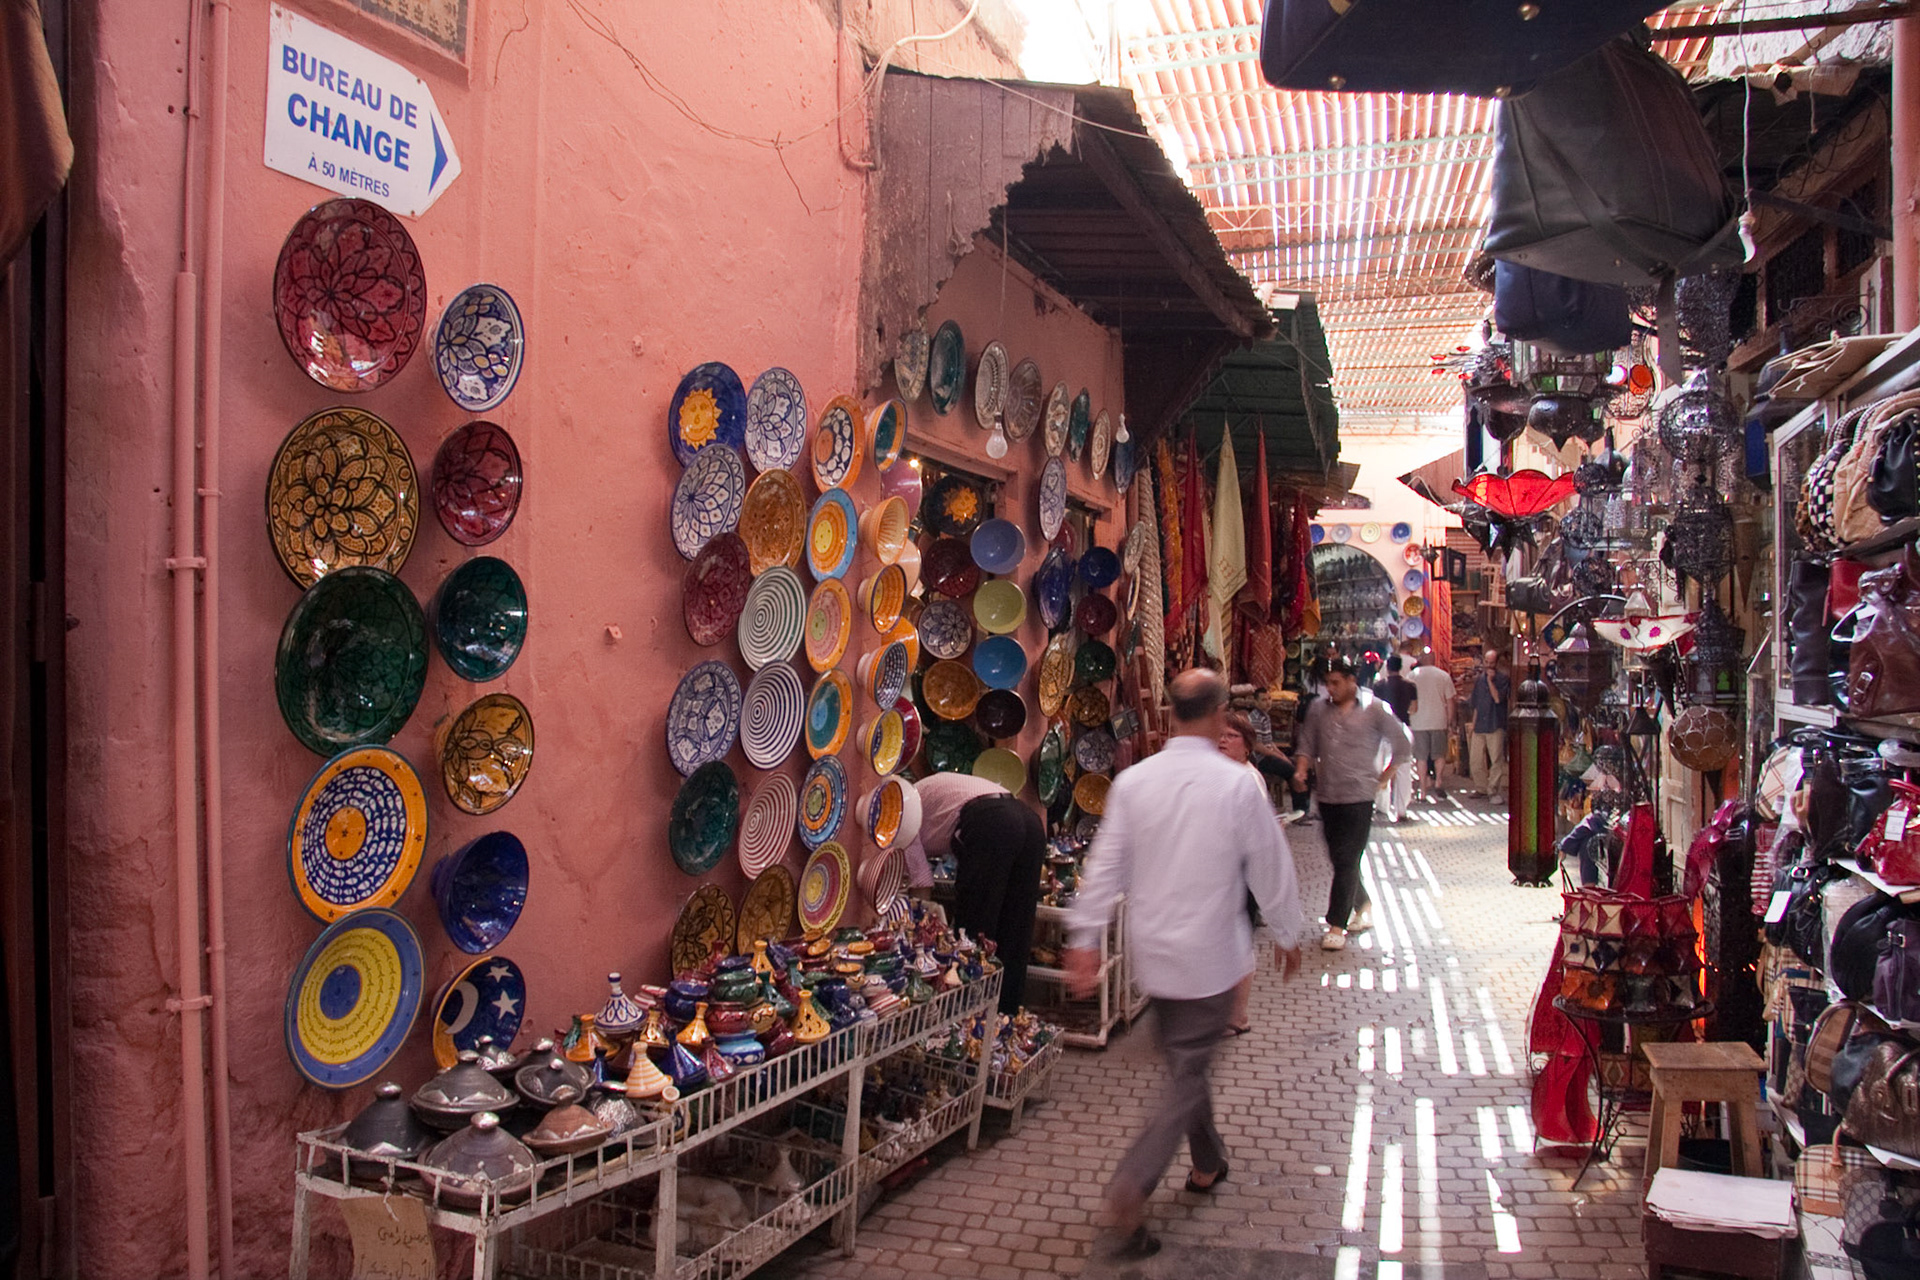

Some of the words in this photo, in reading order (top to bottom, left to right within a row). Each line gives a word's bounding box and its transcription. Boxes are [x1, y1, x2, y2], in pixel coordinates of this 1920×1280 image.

[283, 44, 382, 111] BUREAU
[390, 94, 417, 128] DE
[288, 93, 410, 171] CHANGE
[307, 151, 318, 172] À
[322, 161, 335, 177] 50
[339, 167, 390, 198] MÈTRES
